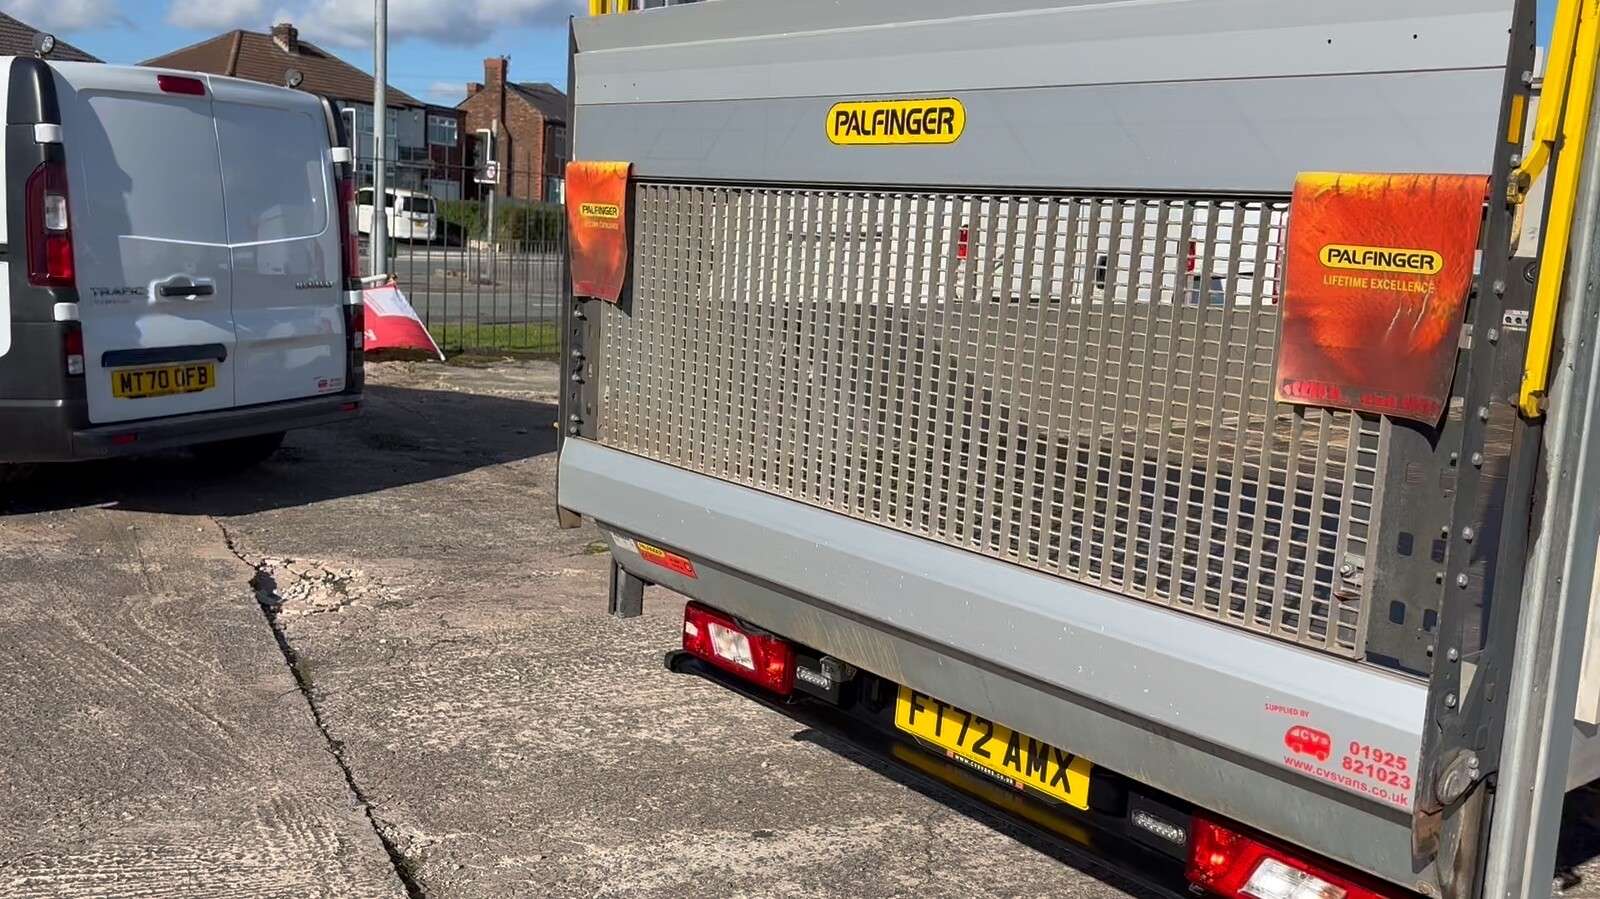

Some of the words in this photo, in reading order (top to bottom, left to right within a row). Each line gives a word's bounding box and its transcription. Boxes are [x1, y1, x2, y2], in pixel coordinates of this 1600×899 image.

[835, 106, 955, 136] PALFINGER
[582, 205, 618, 216] PALFINGER
[1327, 248, 1435, 270] PALFINGER
[1323, 274, 1369, 289] LIFETIME
[1370, 278, 1436, 294] EXCELLENCE
[120, 369, 169, 393] MT70
[174, 366, 208, 388] OFB
[1265, 703, 1299, 716] SUPPLIED
[1300, 709, 1310, 719] BY
[908, 689, 995, 760] FT72
[1002, 730, 1077, 795] AMX
[1349, 741, 1407, 771] 01925
[1284, 755, 1409, 806] www.cvsvans.co.uk
[1342, 756, 1411, 790] 821023
